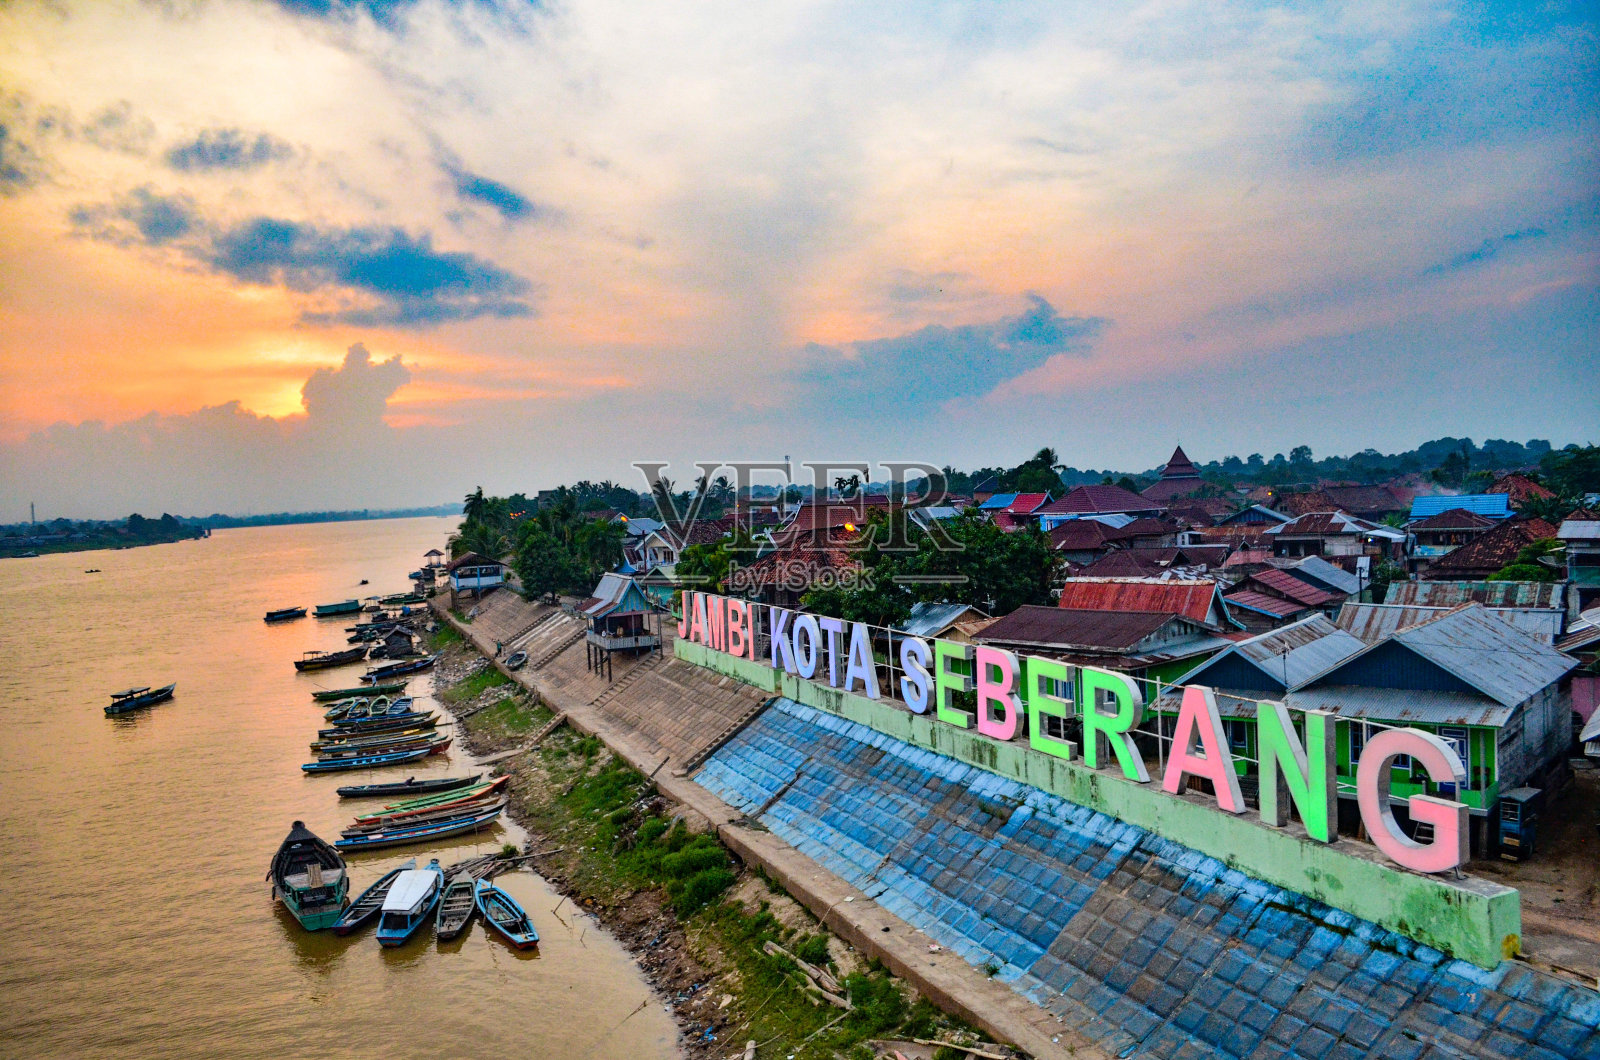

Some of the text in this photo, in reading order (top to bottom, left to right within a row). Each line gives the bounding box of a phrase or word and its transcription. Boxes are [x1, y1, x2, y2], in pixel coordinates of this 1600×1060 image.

[677, 590, 1470, 874] JAMBI KOTA SEBERANG
